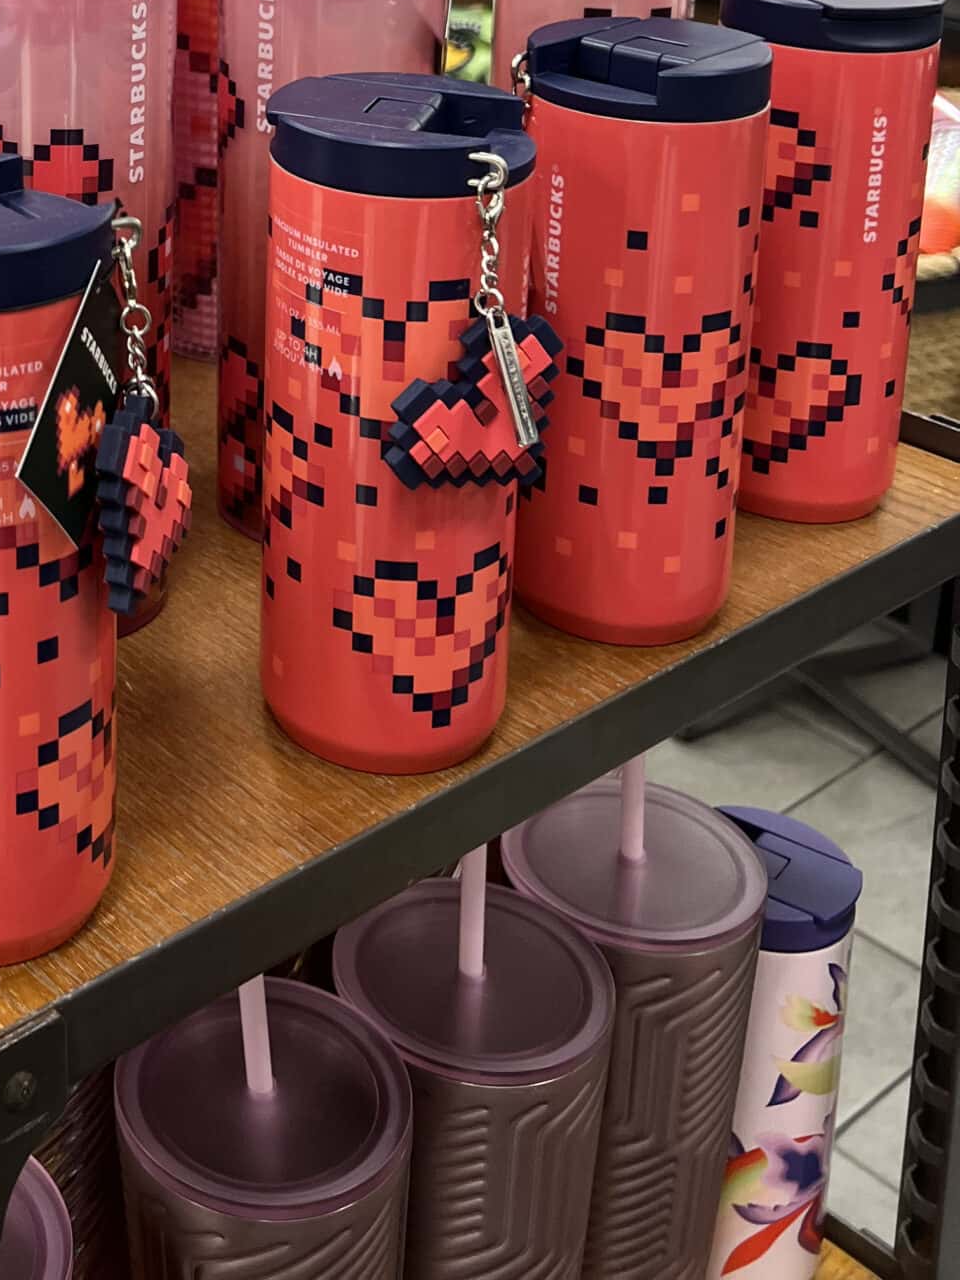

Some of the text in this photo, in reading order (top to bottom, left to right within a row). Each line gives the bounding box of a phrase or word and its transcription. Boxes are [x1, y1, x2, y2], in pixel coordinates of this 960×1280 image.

[129, 0, 148, 184] STARBUCKS
[863, 115, 888, 243] STARBUCKS
[288, 238, 328, 262] TUMBLER
[302, 233, 359, 258] INSULATED
[544, 173, 565, 315] STARBUCKS
[307, 265, 351, 286] VOYAGE
[5, 411, 35, 426] VIDE
